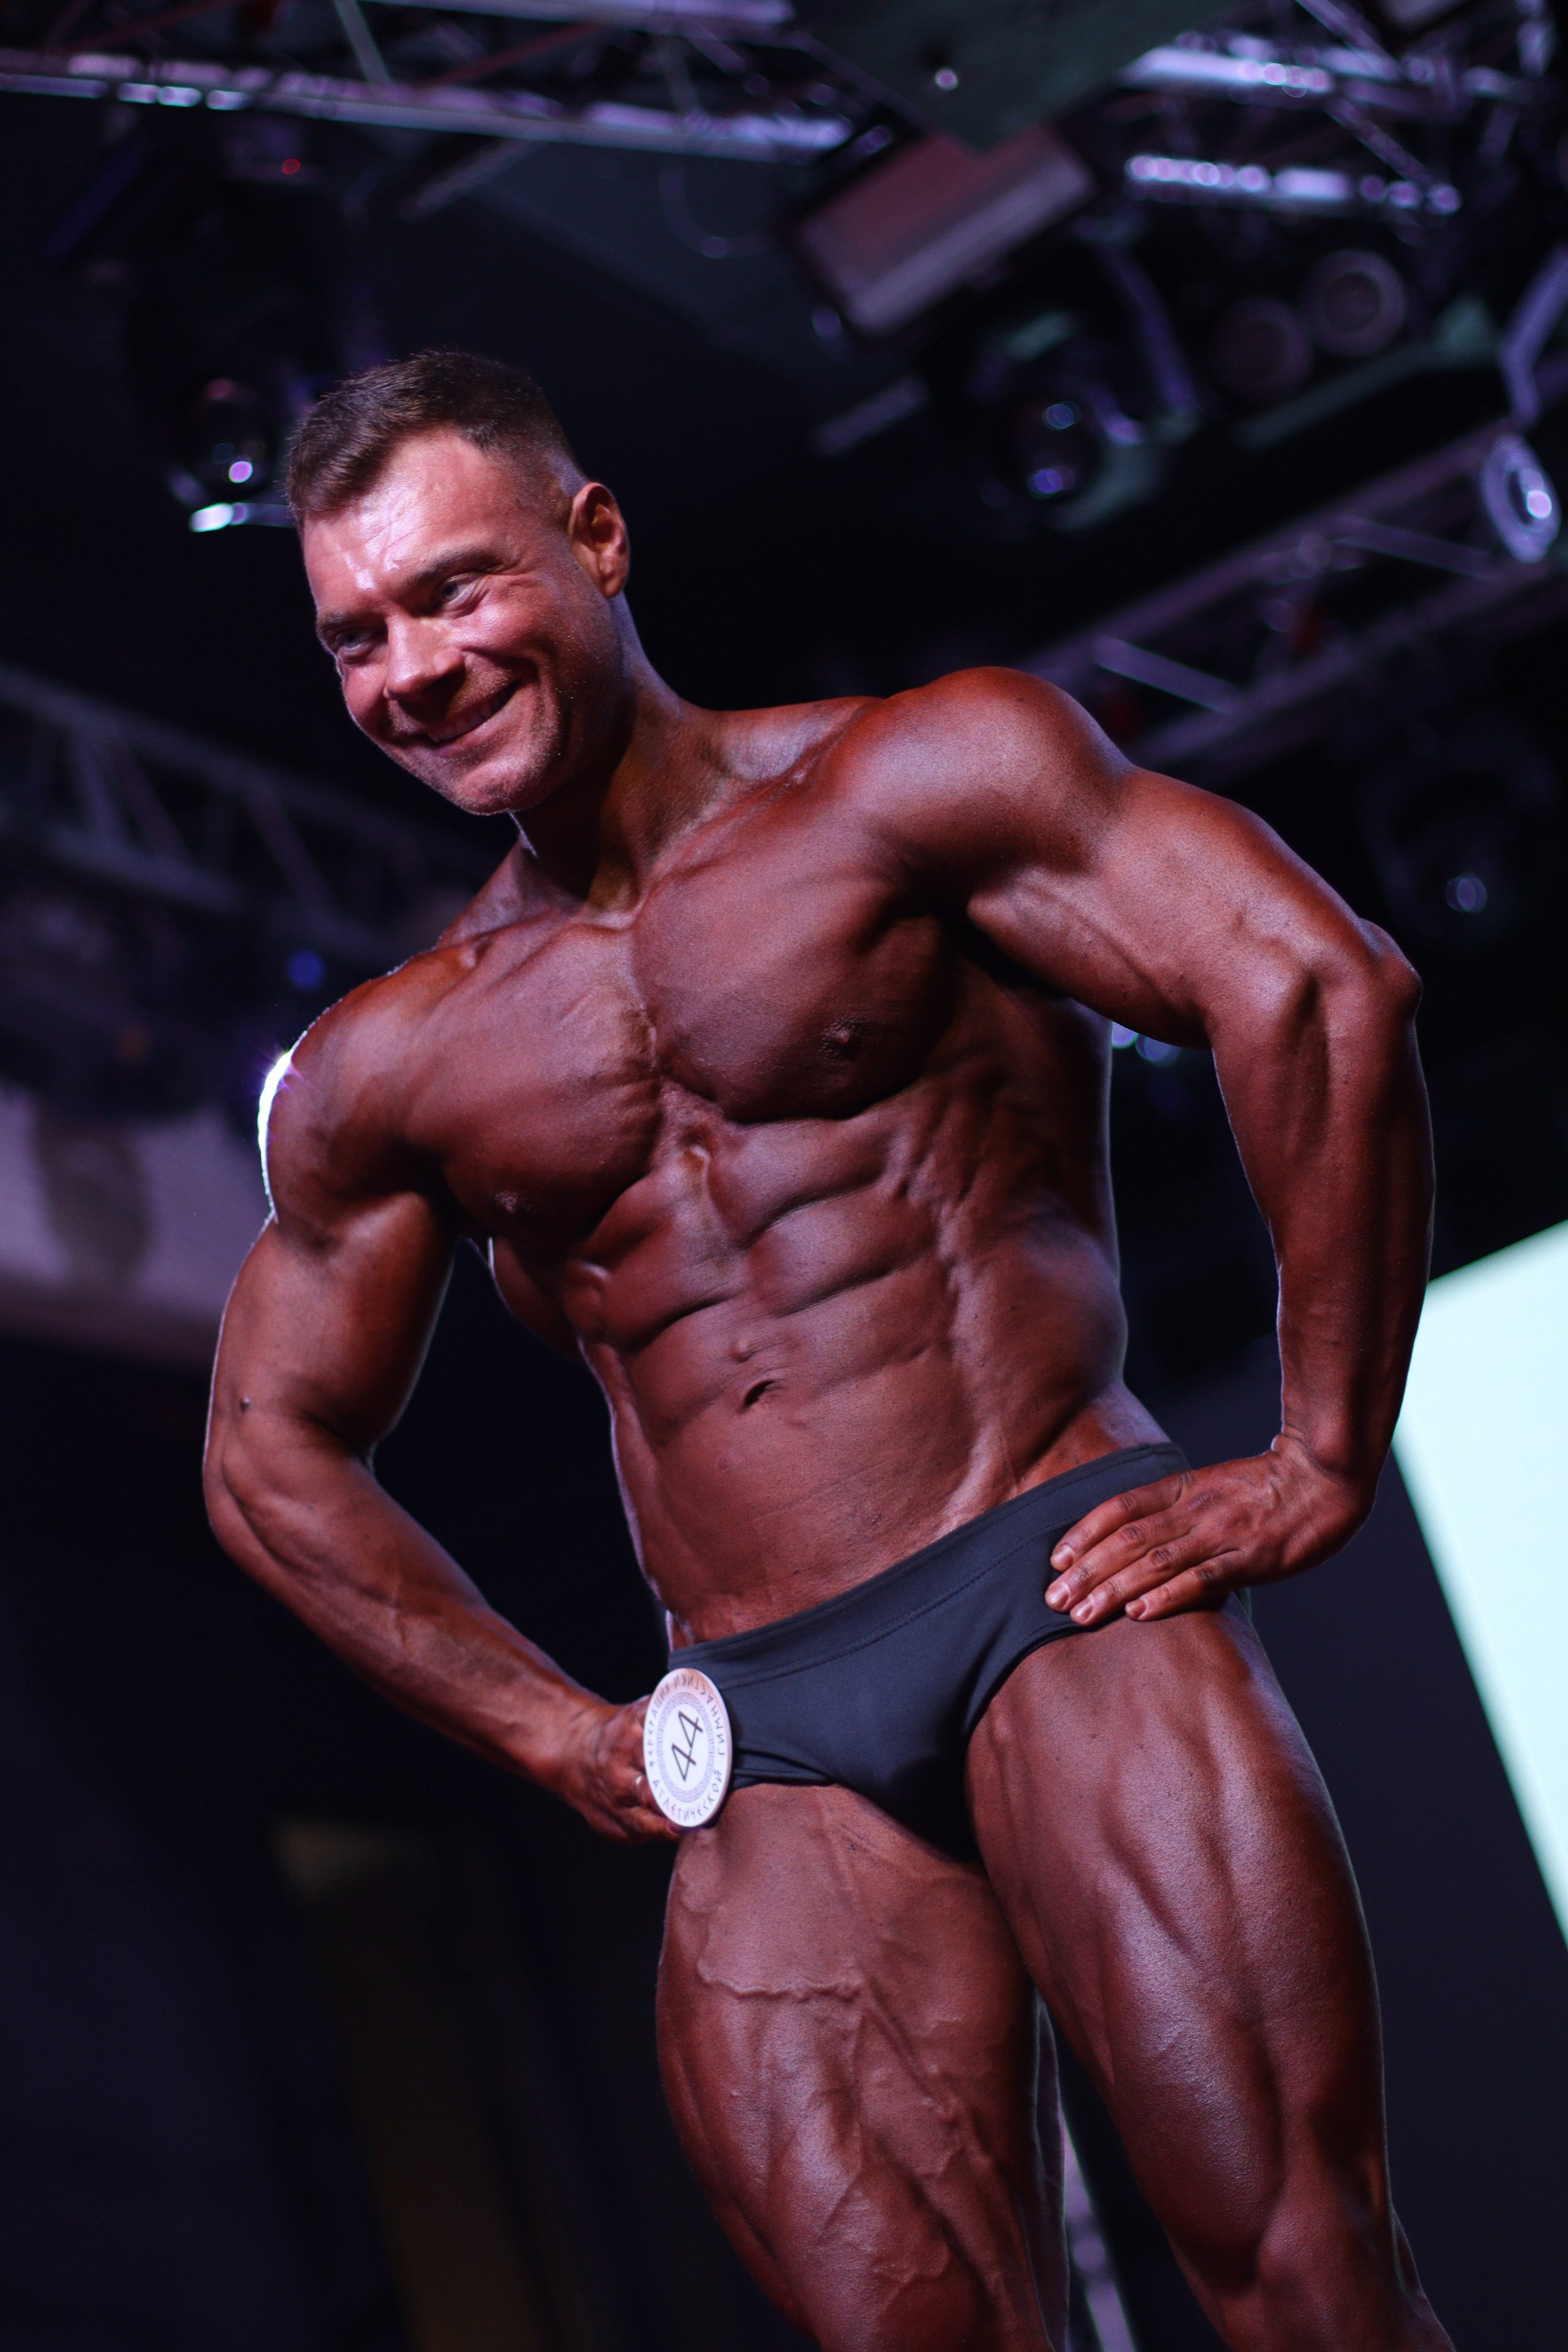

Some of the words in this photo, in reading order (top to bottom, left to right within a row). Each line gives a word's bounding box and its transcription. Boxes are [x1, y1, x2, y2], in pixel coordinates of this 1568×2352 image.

[647, 1684, 670, 1768] ФЕДЕРАЦИЯ
[671, 1709, 703, 1782] 44
[673, 1673, 726, 1755] ГИМНАСТИКИ
[652, 1769, 723, 1822] АТЛЕТИЧЕСКОЙ
